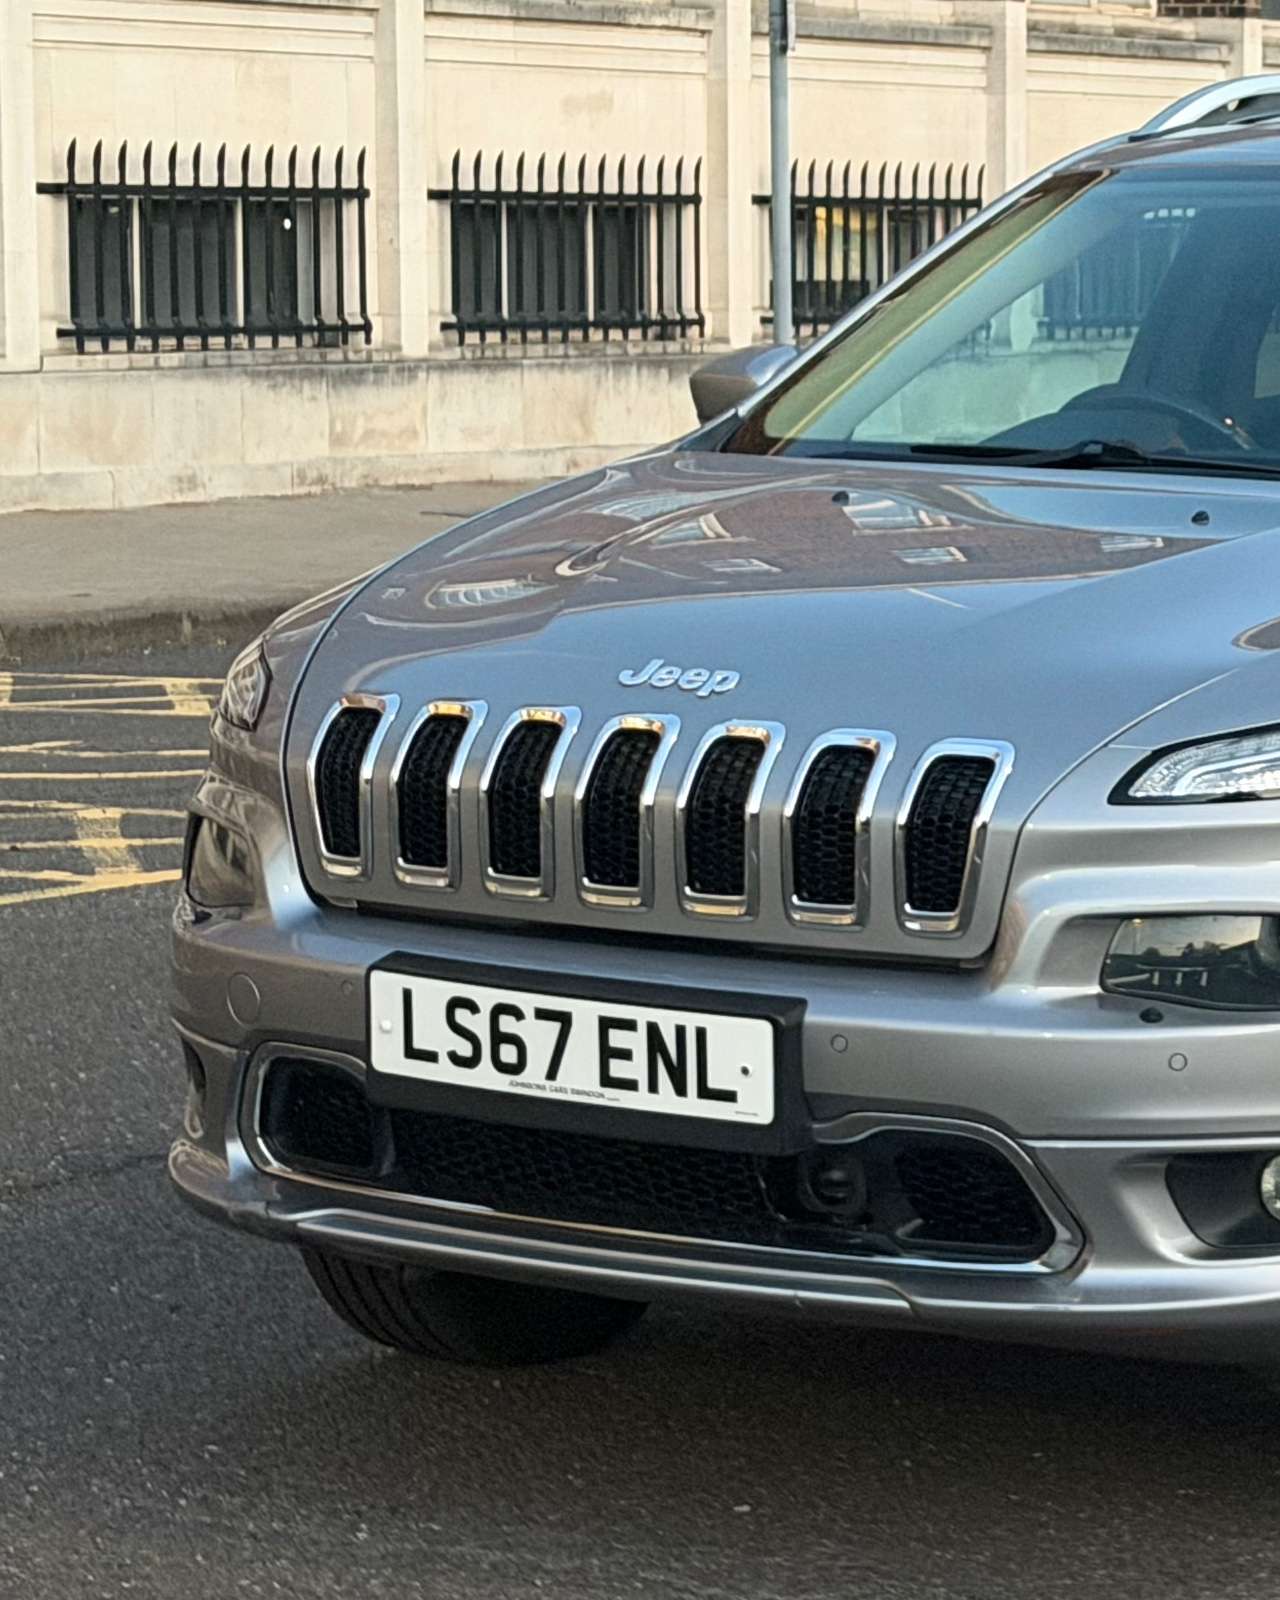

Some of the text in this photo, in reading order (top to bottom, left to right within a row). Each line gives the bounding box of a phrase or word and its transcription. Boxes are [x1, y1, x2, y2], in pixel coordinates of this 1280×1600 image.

[618, 658, 741, 697] Jeep
[402, 986, 739, 1104] LS67 ENL
